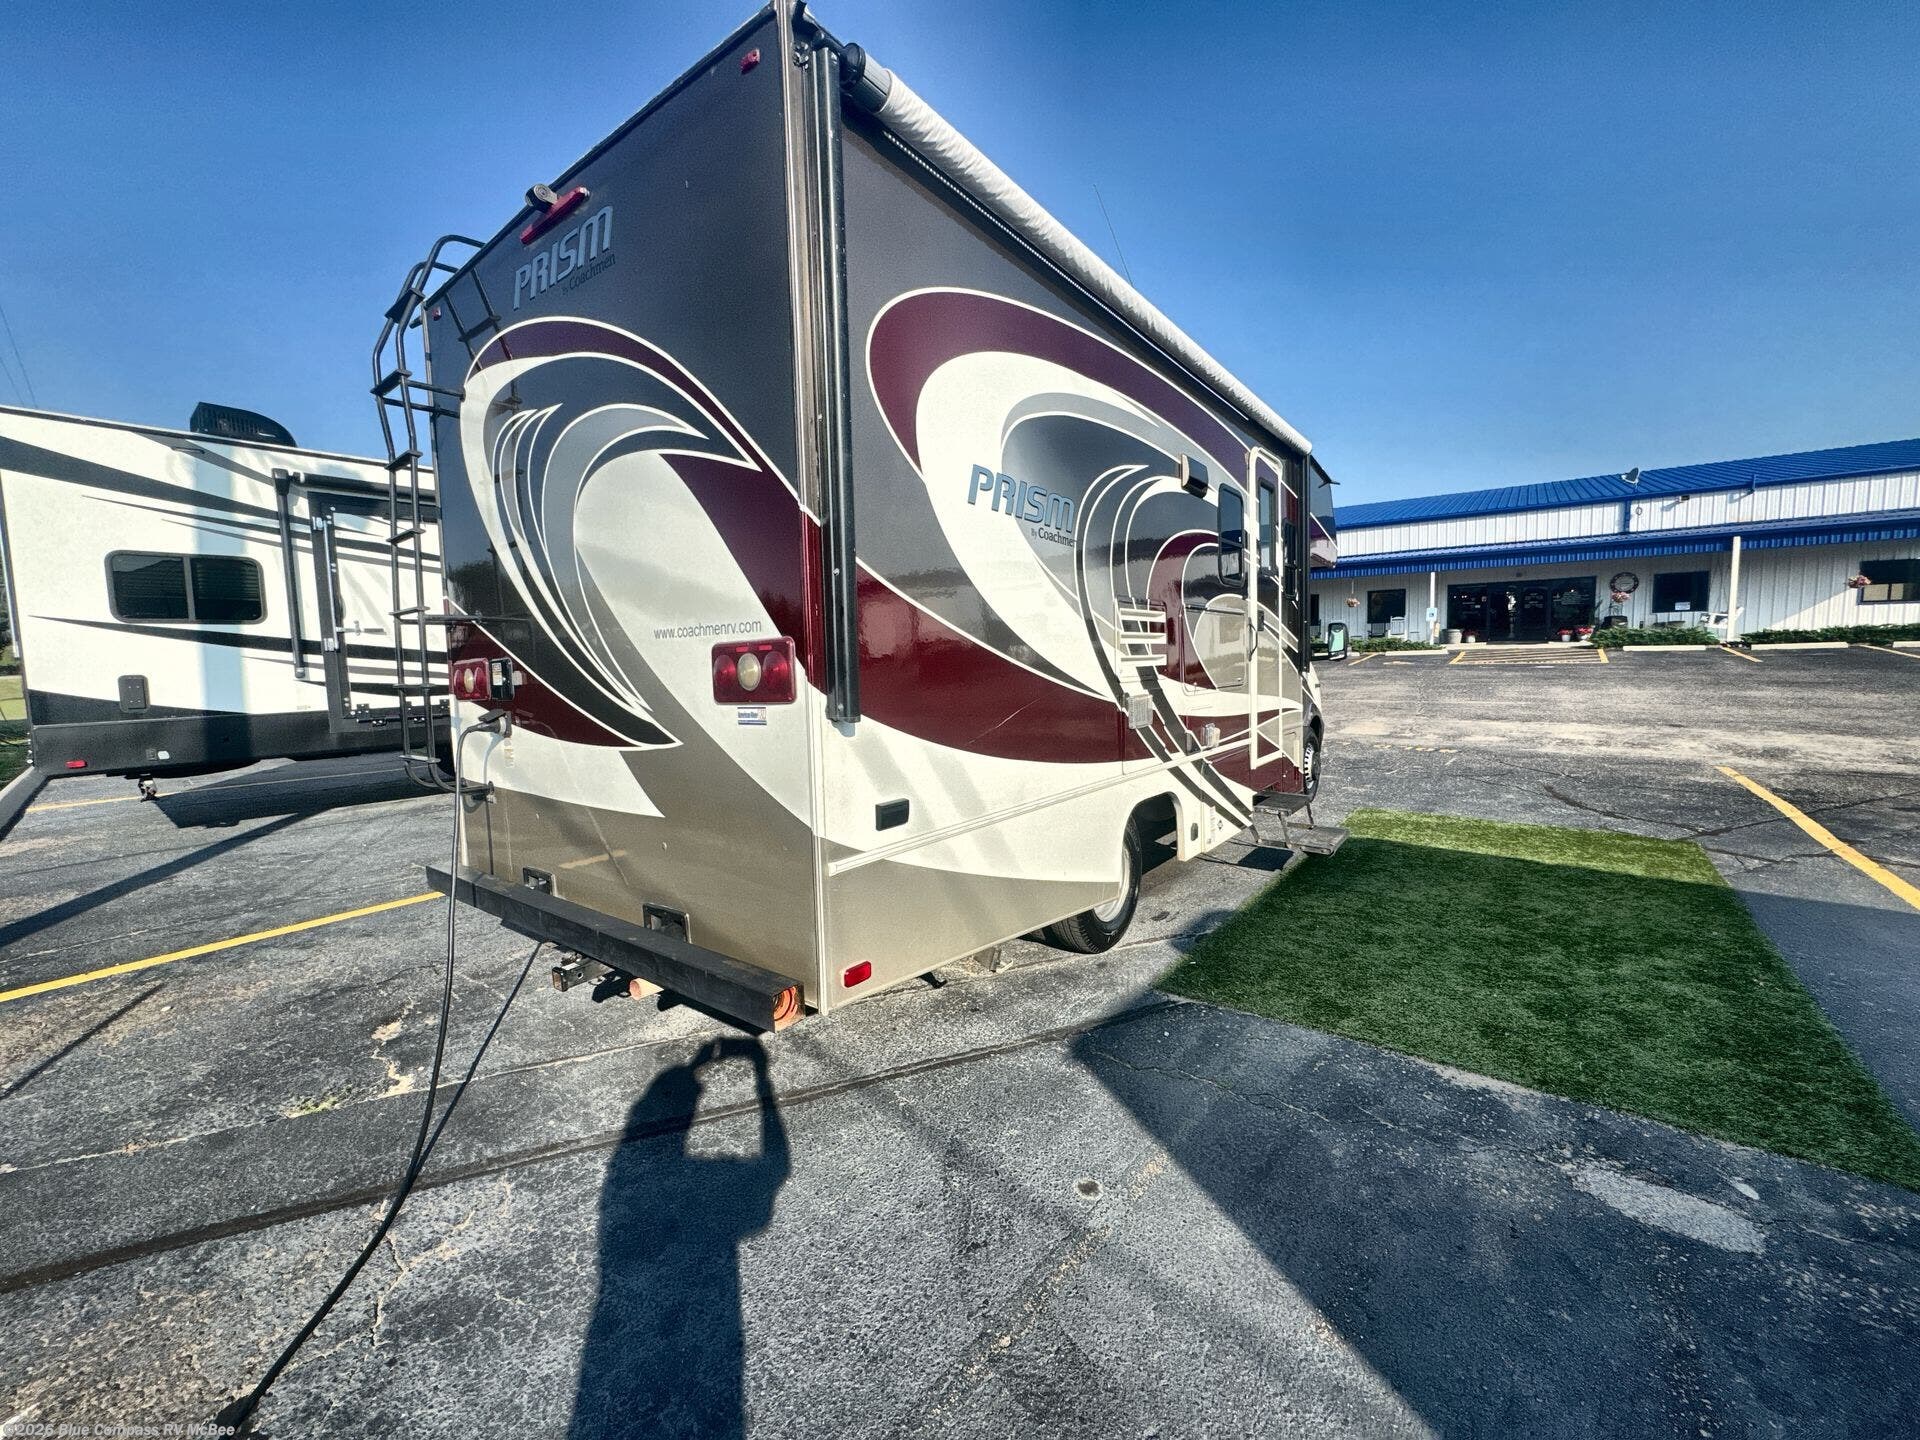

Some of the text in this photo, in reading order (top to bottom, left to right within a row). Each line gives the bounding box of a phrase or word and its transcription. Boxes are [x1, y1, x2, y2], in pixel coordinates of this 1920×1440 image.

[513, 206, 613, 310] PRISM
[569, 253, 616, 290] Coachmen
[967, 463, 1075, 534] PRISM
[1038, 527, 1077, 547] Coachme
[654, 621, 761, 639] www.coachmenrv.com
